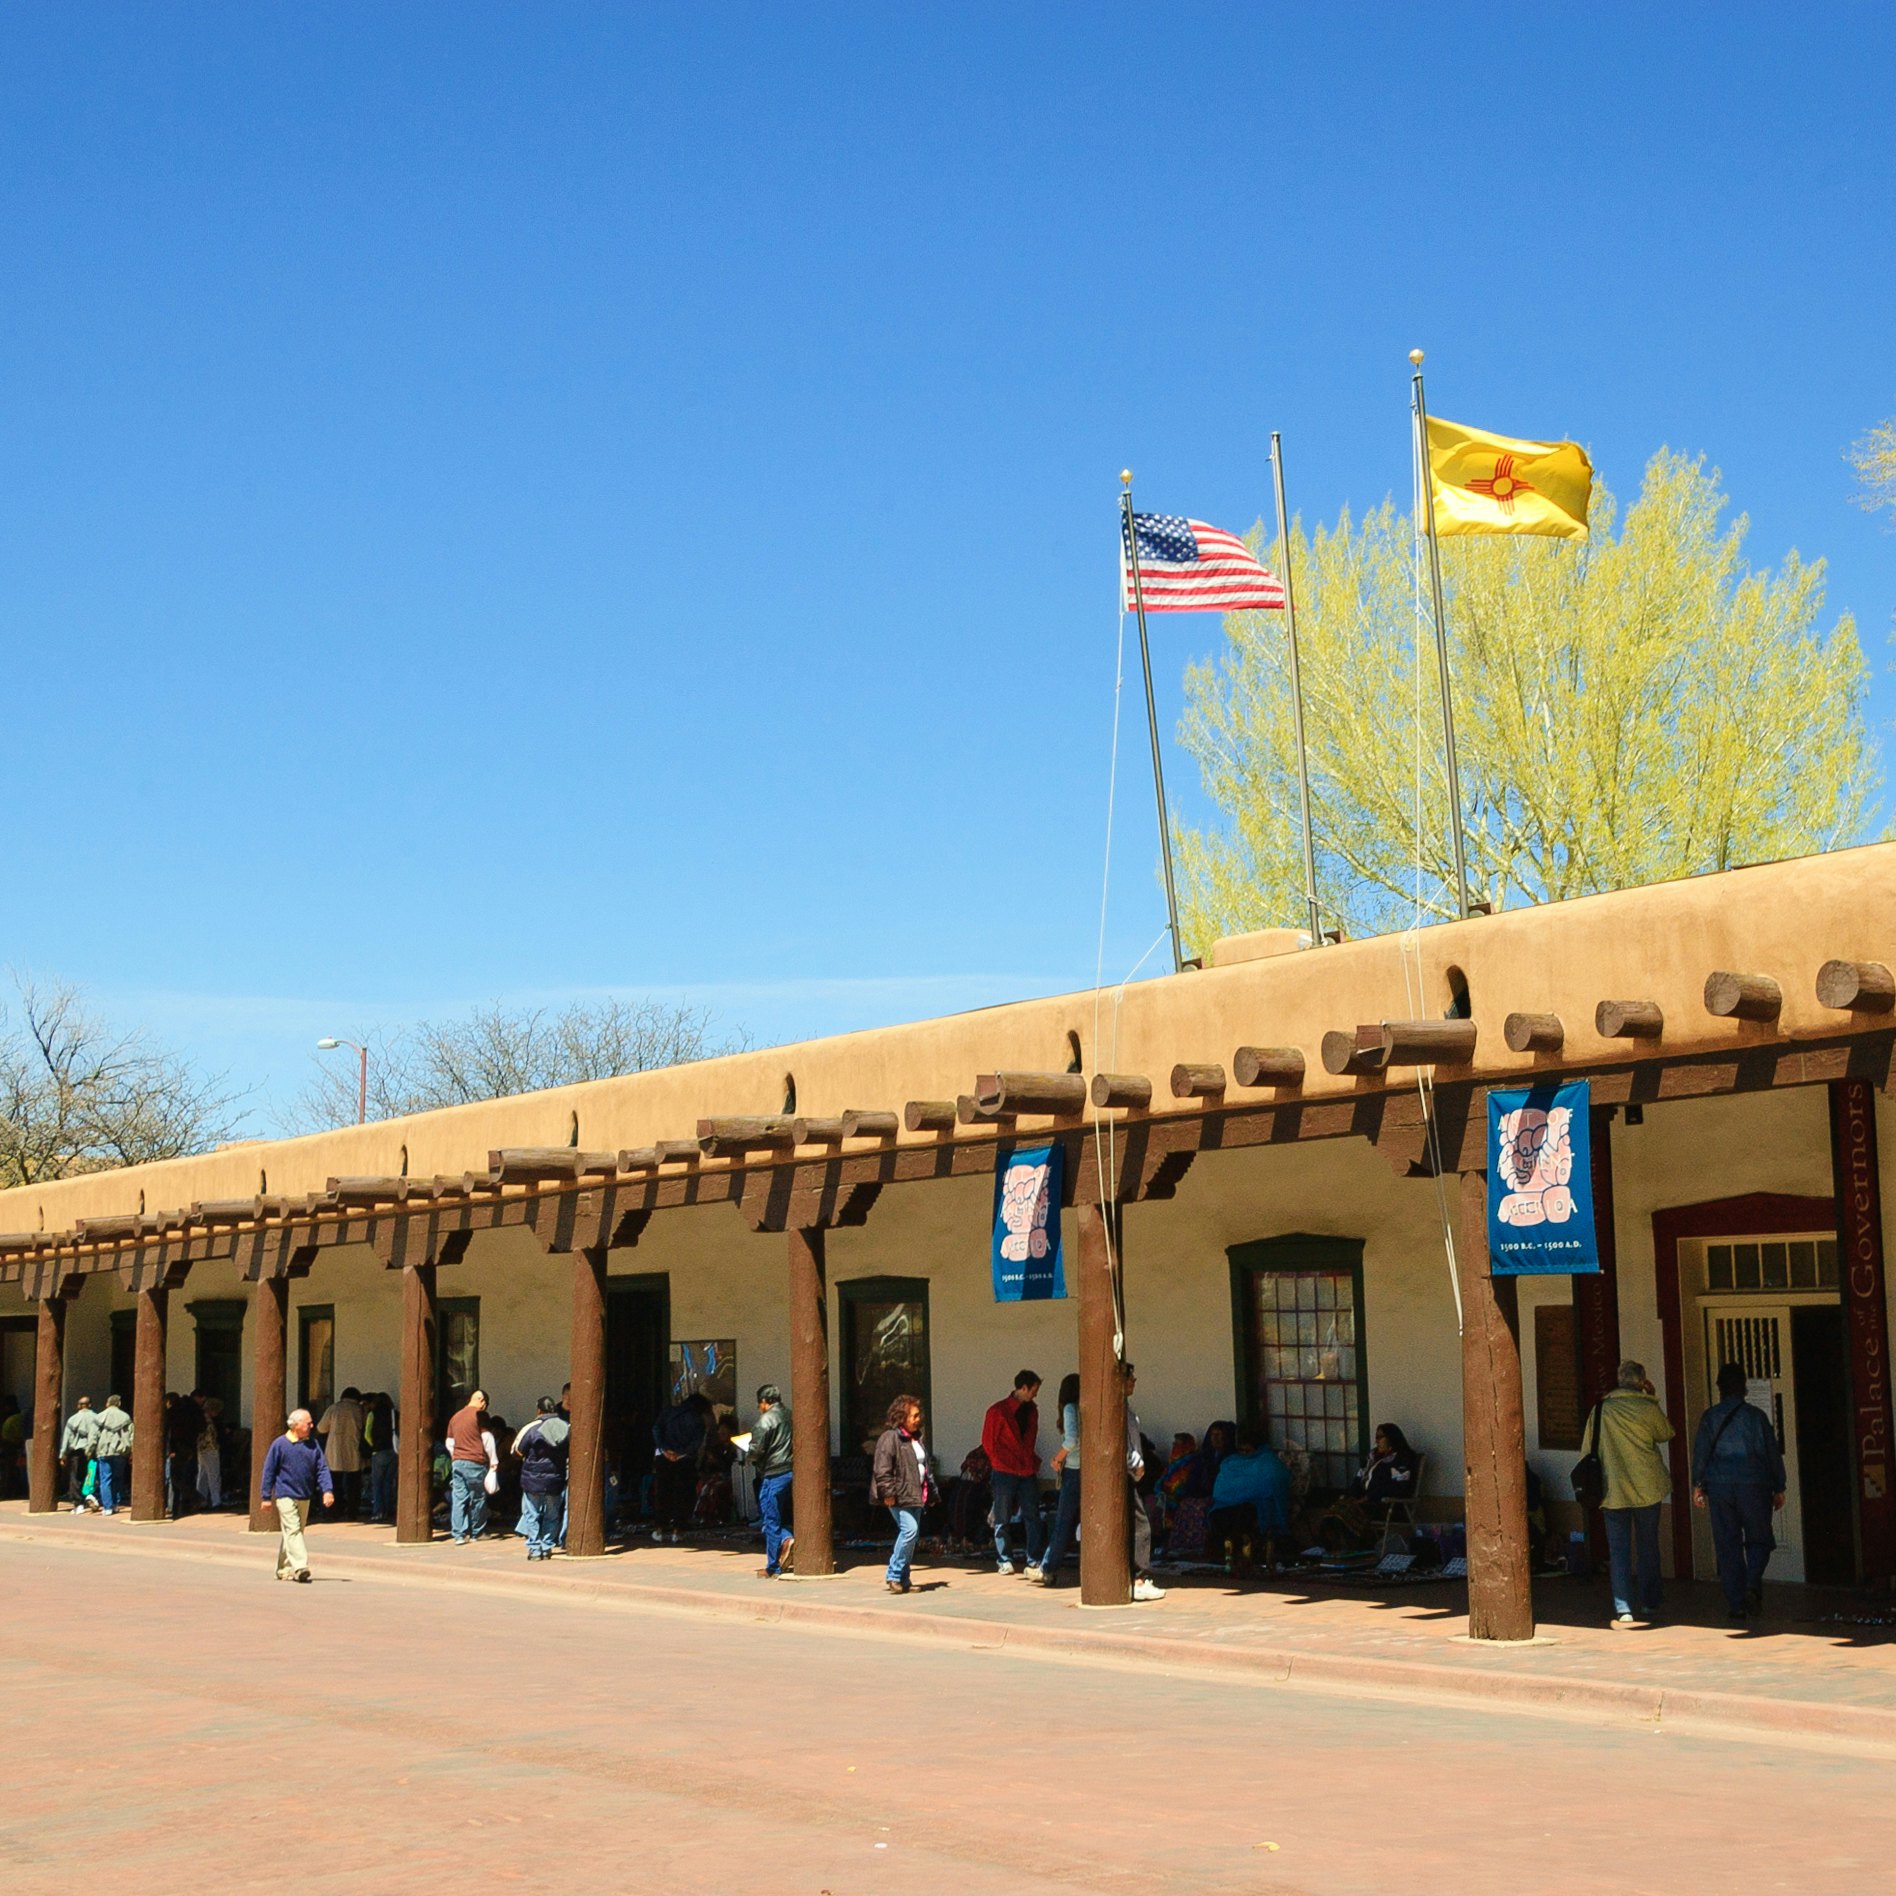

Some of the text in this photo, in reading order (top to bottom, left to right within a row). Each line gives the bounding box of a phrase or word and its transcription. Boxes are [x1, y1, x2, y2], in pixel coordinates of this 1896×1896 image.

[1547, 1108, 1573, 1127] OF
[1848, 1083, 1876, 1299] Governors
[1500, 1242, 1519, 1252] 1500
[1521, 1242, 1536, 1250] B.C.
[1544, 1241, 1564, 1251] 1500
[1565, 1240, 1582, 1249] A.D.
[1859, 1336, 1887, 1459] Palace
